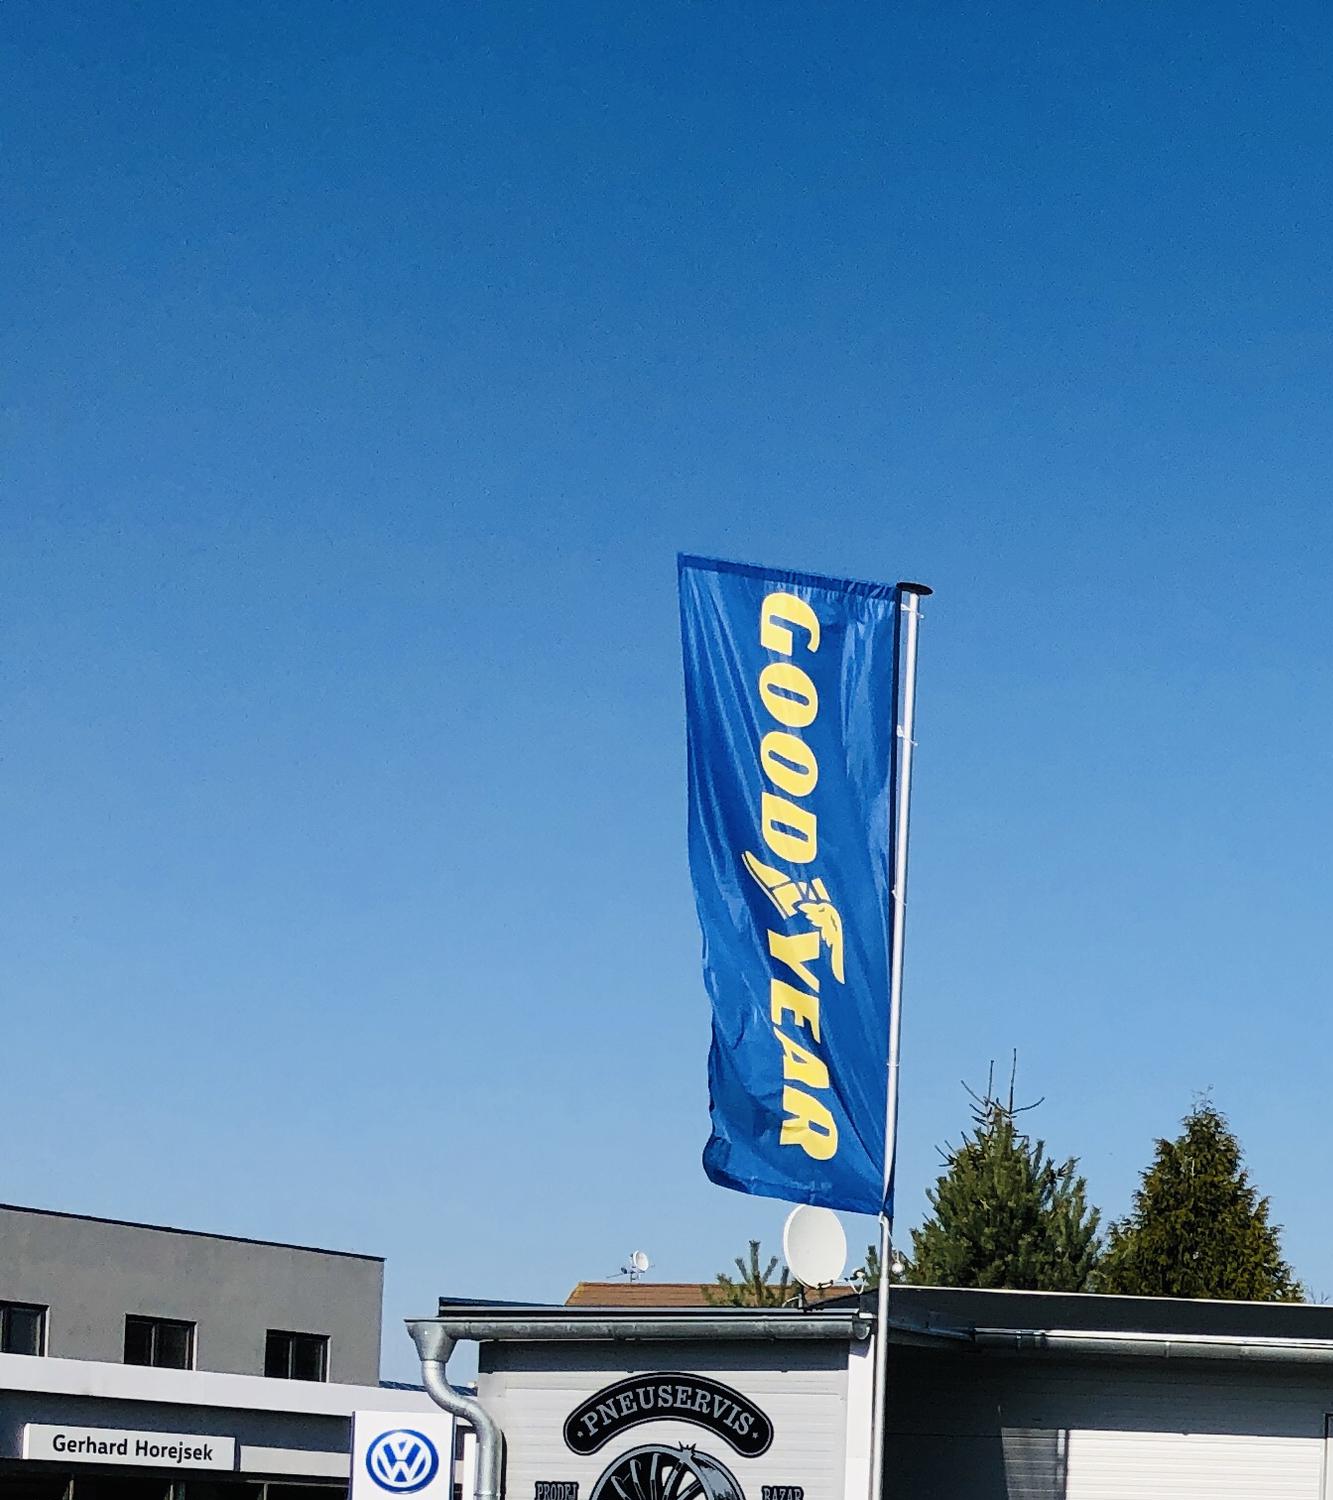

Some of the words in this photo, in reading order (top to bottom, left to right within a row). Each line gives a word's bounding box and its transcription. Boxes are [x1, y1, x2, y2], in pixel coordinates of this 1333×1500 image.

[759, 592, 839, 1162] GOODYEAR
[580, 1385, 755, 1437] PNEUSERVIS
[52, 1433, 128, 1456] Gerhard
[135, 1439, 213, 1464] Horejsek
